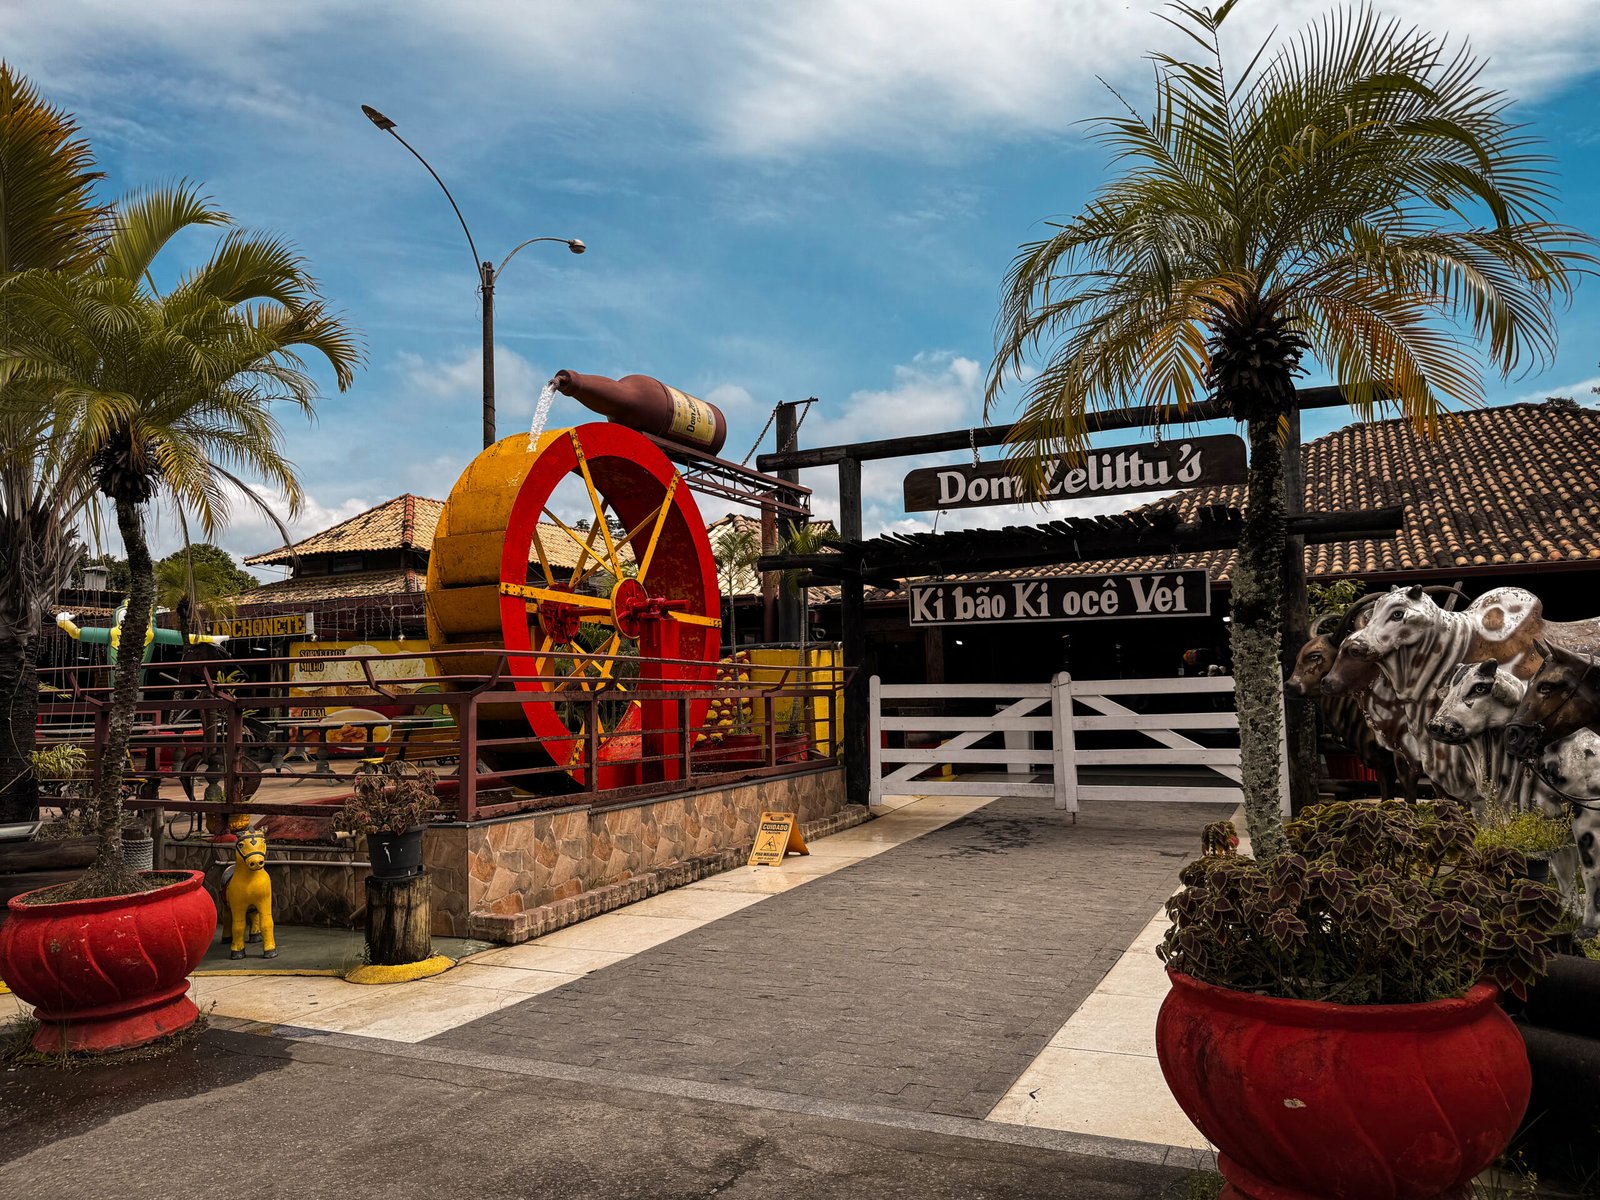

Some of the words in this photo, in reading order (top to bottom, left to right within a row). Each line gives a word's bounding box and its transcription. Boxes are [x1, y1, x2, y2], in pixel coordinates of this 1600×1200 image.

[686, 413, 696, 432] Dom
[936, 471, 1027, 504] Dom
[1036, 444, 1202, 495] Zelittu's
[911, 587, 945, 622] Ki
[953, 586, 1006, 621] bão
[1012, 581, 1050, 617] Ki
[1062, 578, 1119, 616] ocê
[1126, 575, 1188, 613] Vei
